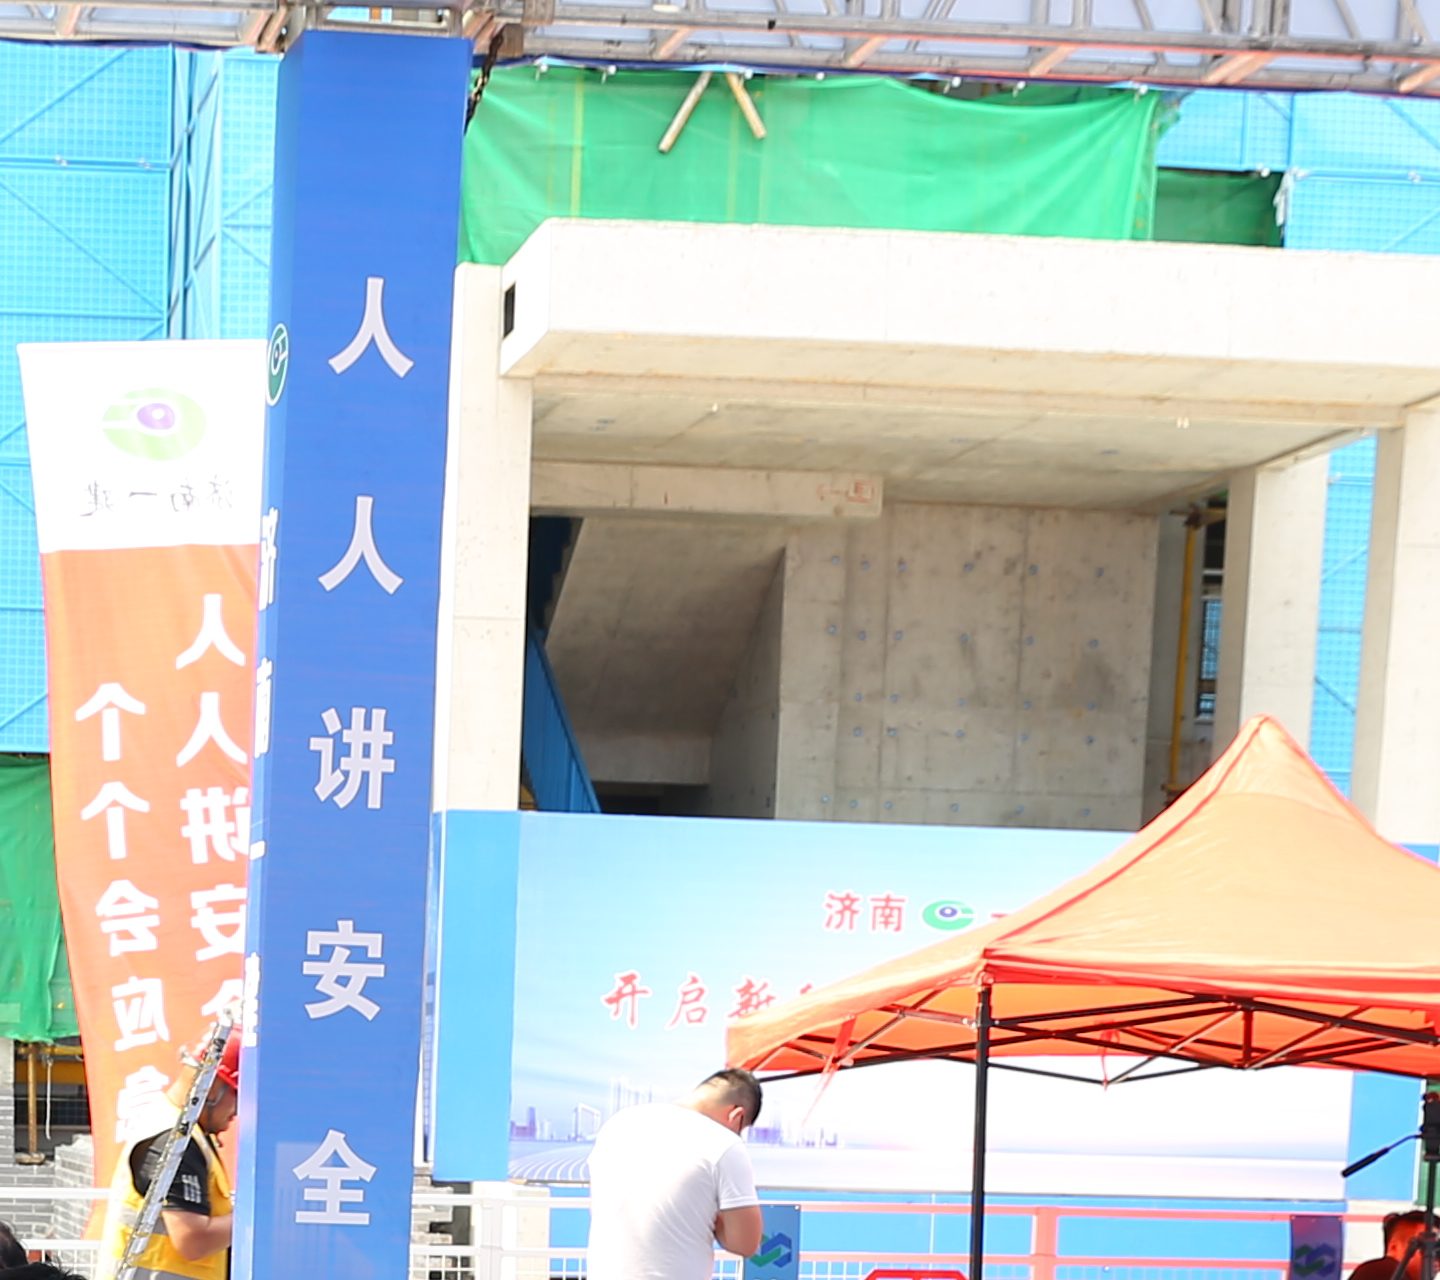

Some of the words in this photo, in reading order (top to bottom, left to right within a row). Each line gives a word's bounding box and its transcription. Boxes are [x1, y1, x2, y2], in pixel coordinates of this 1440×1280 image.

[292, 276, 415, 1228] 人人讲安全
[824, 891, 907, 932] 济南
[602, 971, 813, 1030] 开启新
